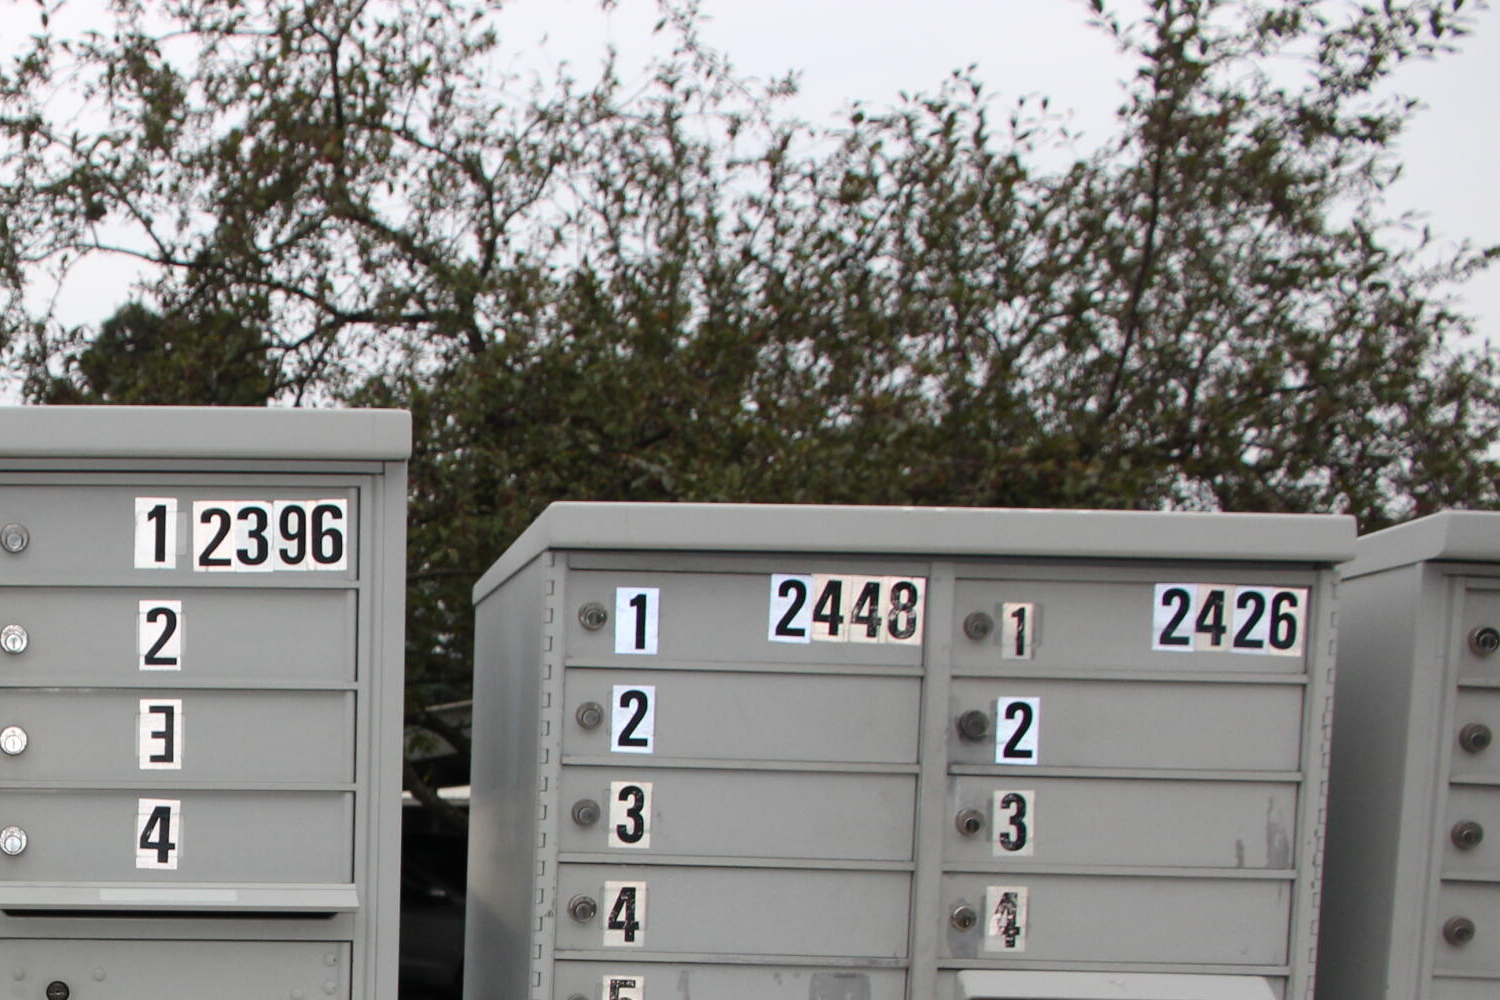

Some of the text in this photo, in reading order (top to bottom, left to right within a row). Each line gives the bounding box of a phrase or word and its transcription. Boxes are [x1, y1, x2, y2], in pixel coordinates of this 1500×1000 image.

[147, 504, 343, 567] 1 2396
[144, 607, 178, 666] 2
[629, 593, 647, 650] 1
[775, 579, 918, 640] 2448
[1011, 607, 1026, 657] 1
[1159, 586, 1298, 650] 2426
[617, 689, 648, 747] 2
[1003, 701, 1033, 759] 2
[139, 806, 176, 864] 4
[616, 785, 645, 844] 3
[999, 792, 1027, 852] 3
[607, 886, 640, 943] 4
[991, 891, 1022, 949] 4
